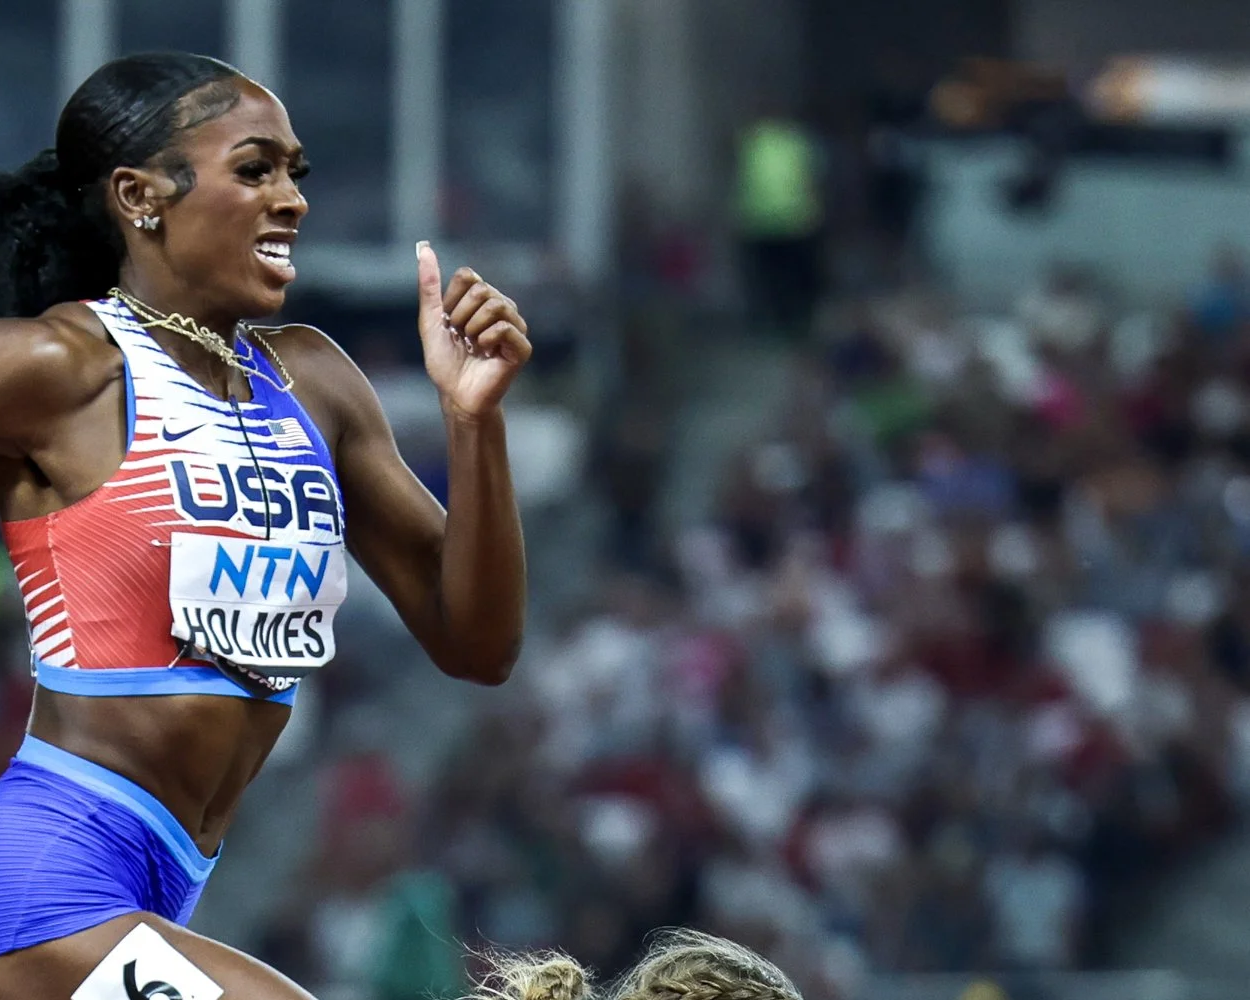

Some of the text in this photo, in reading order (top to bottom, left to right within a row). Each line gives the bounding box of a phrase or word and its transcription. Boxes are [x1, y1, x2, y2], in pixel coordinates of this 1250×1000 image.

[170, 460, 340, 536] USA
[209, 541, 330, 601] NTN
[182, 607, 326, 659] HOLMES
